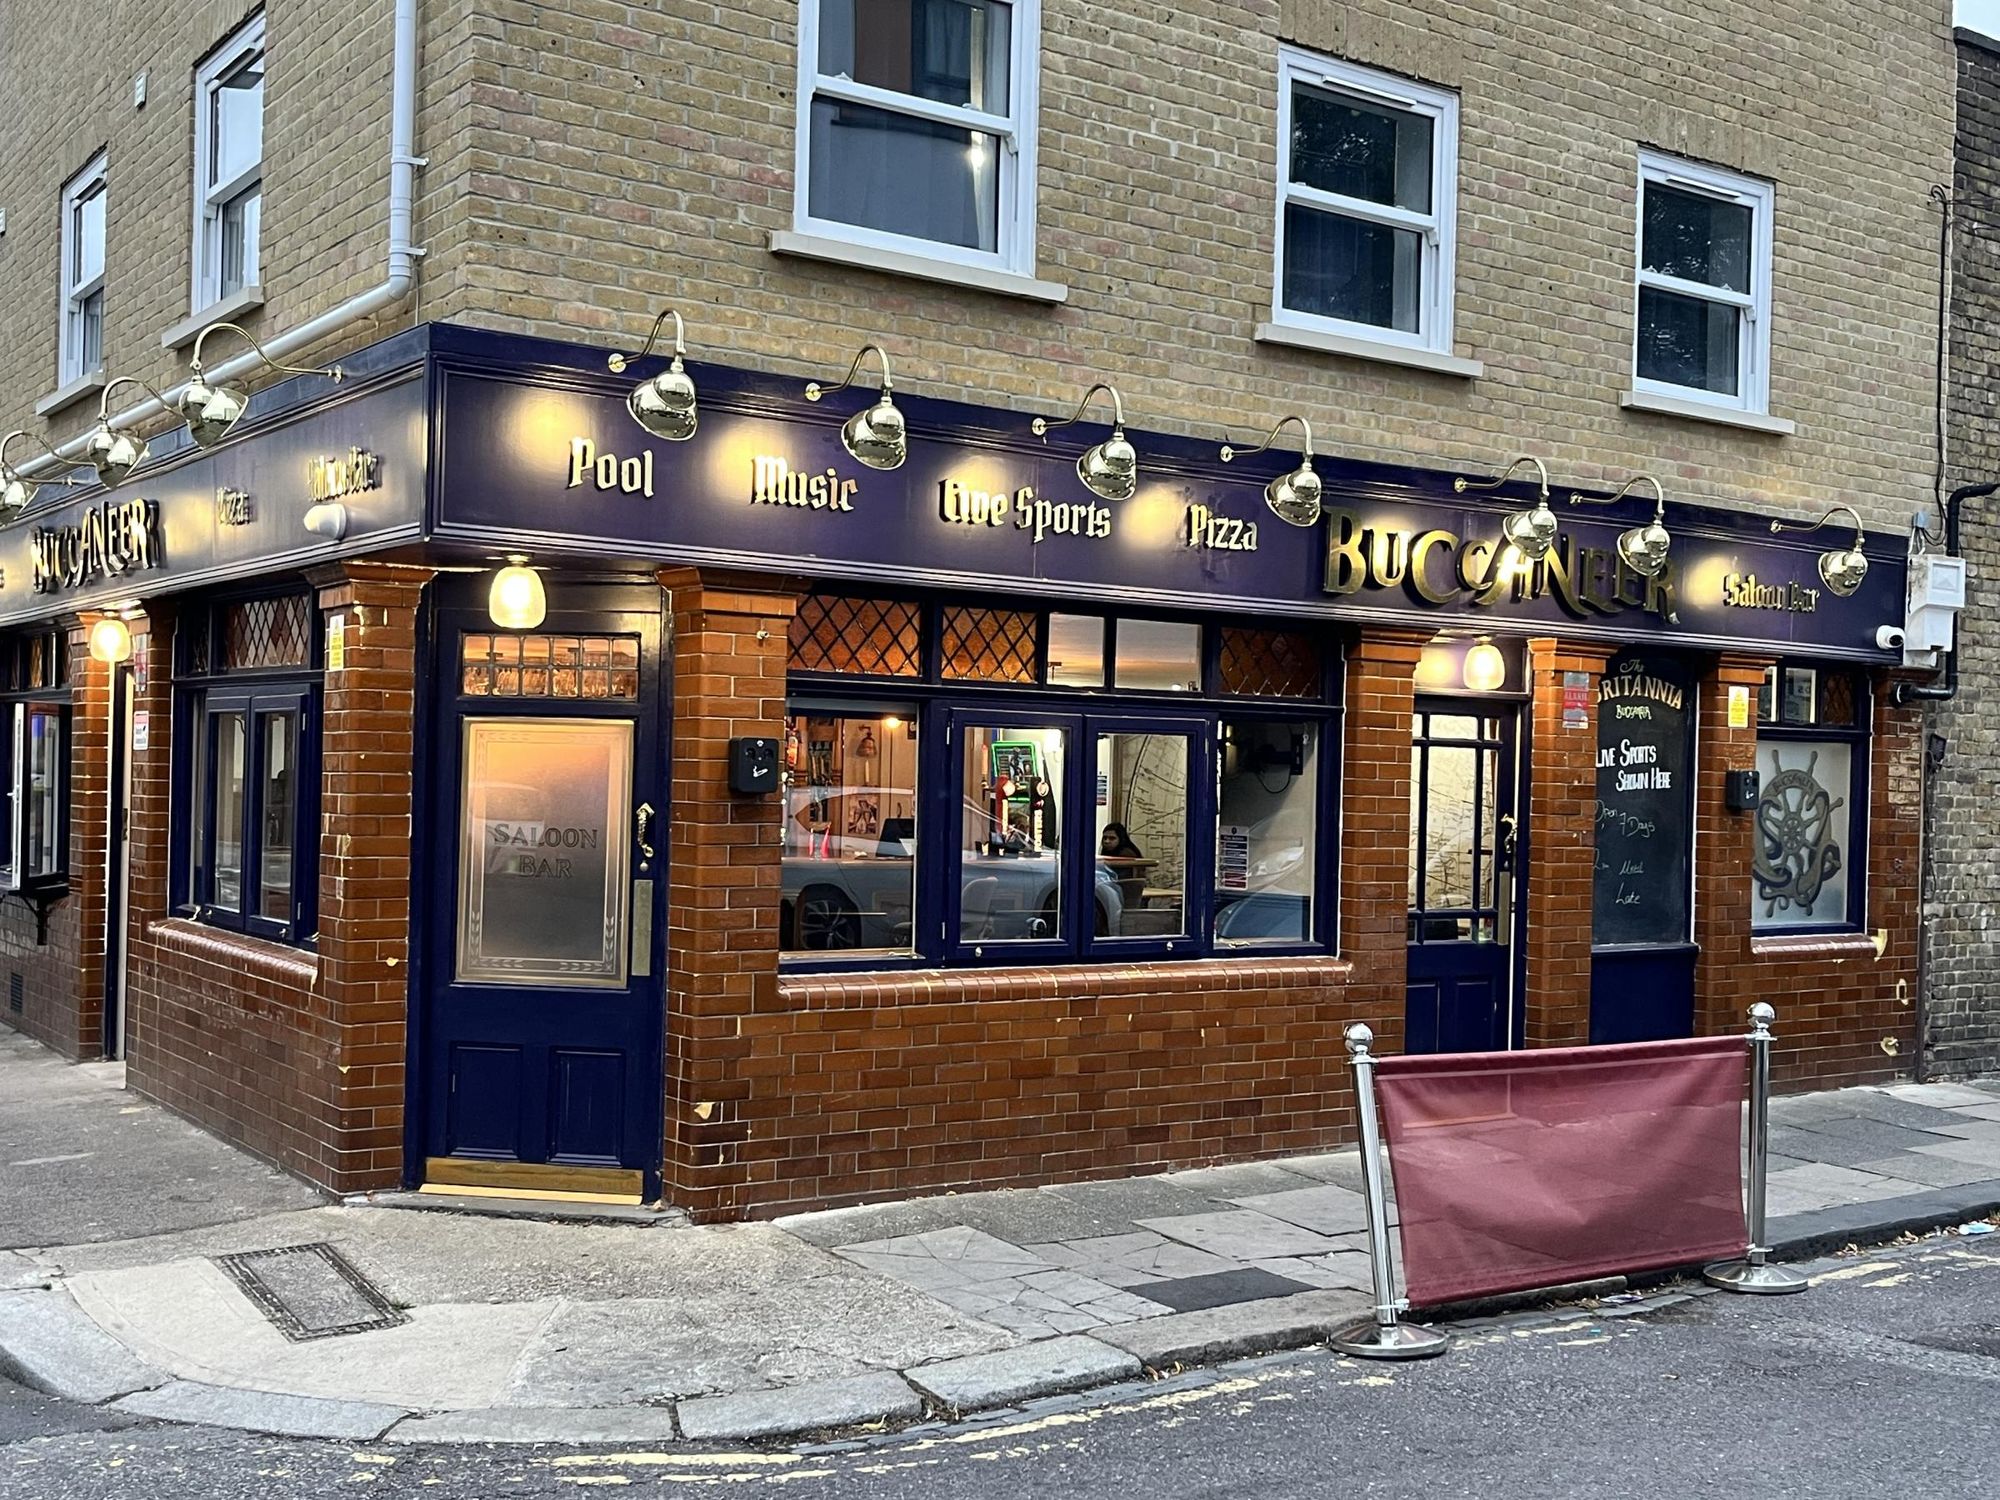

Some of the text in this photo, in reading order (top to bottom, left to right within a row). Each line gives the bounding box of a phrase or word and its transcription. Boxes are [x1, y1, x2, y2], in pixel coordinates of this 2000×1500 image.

[567, 437, 654, 498] Pool
[751, 454, 858, 512] Music
[940, 477, 1111, 544] Live Sports
[1187, 503, 1258, 551] Pizza
[1322, 506, 1681, 625] BUCCANEER
[1723, 572, 1820, 612] Saloon Bar
[1619, 658, 1645, 673] The
[1595, 746, 1616, 768] LIVE
[493, 823, 599, 849] SALOON
[1619, 811, 1627, 836] 7
[1626, 816, 1656, 838] Days
[519, 854, 574, 878] BAR
